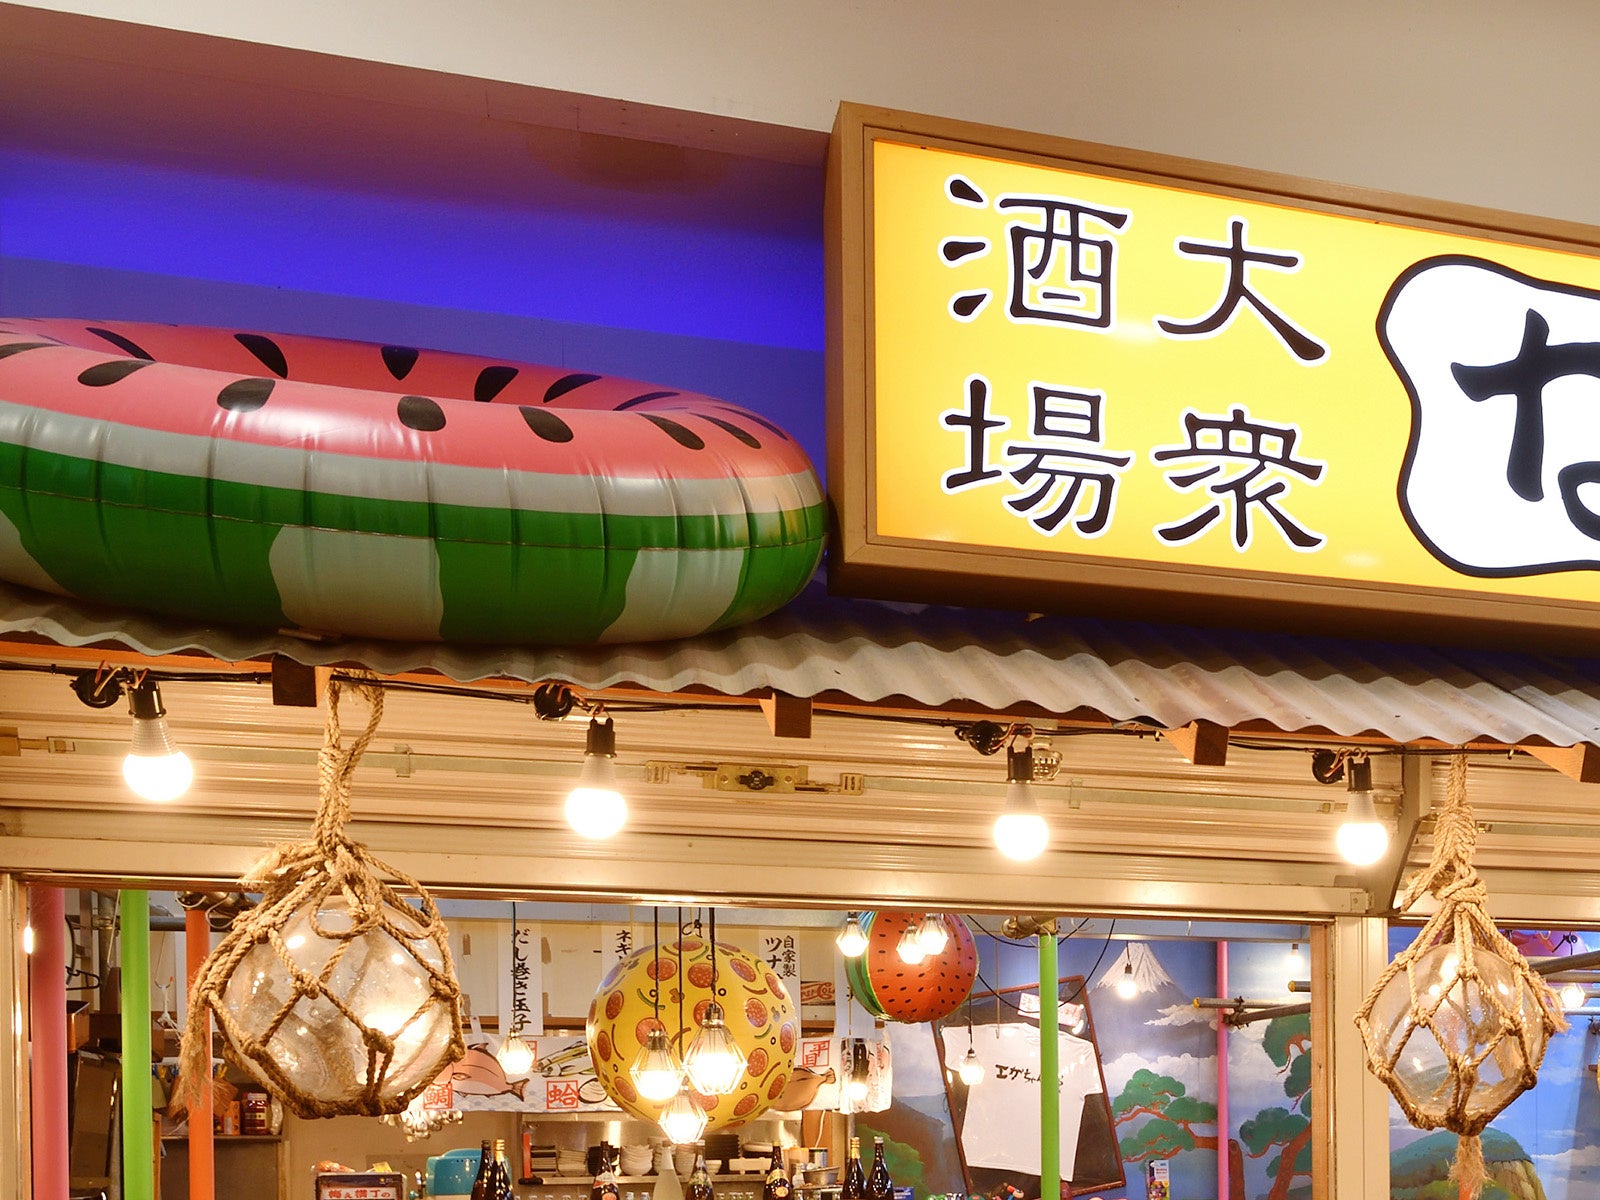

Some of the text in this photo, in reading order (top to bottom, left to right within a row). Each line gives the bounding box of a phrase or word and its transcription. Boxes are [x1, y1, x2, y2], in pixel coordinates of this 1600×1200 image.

[942, 178, 1132, 535] 酒場
[1153, 219, 1327, 548] 大衆
[510, 928, 532, 1032] だし巻き玉子
[765, 936, 784, 980] ツナ
[782, 935, 797, 978] 自家製
[424, 1084, 452, 1108] 鯛
